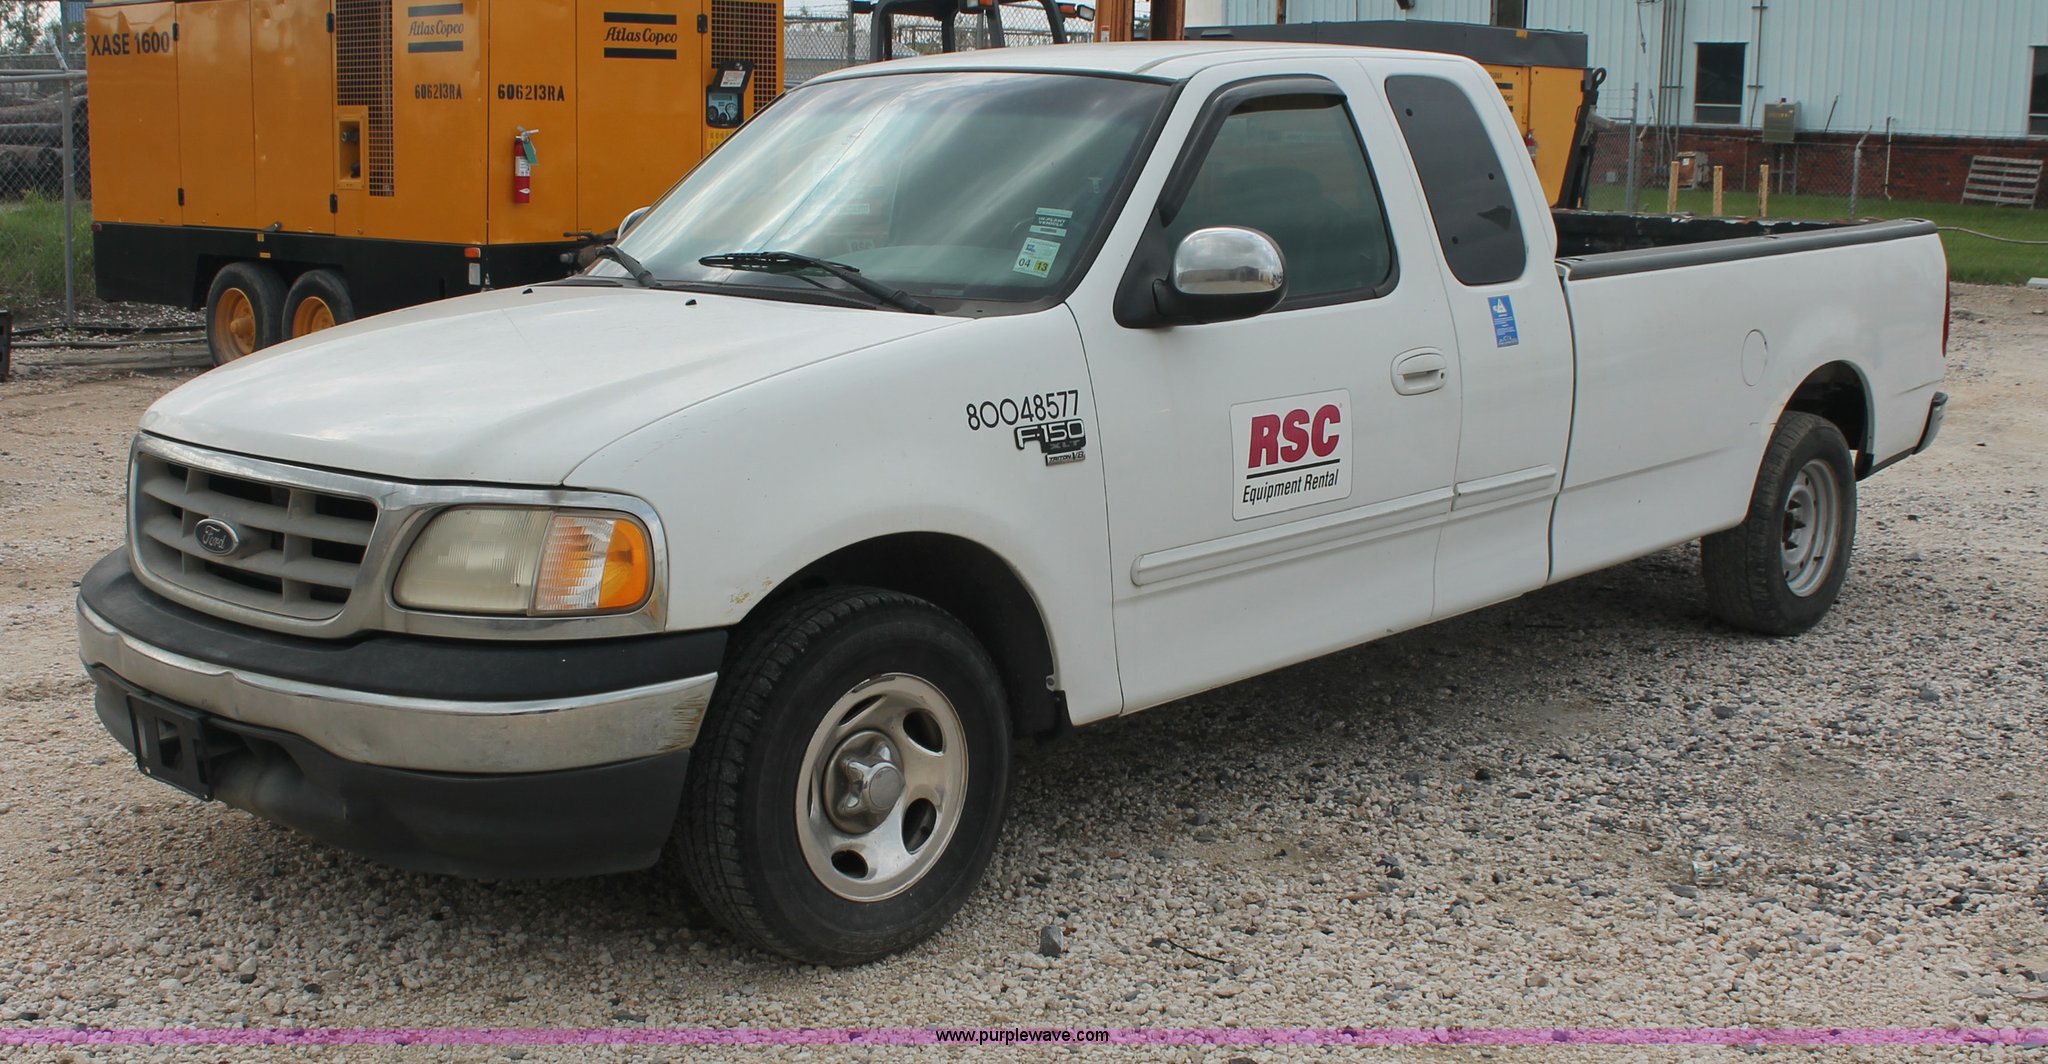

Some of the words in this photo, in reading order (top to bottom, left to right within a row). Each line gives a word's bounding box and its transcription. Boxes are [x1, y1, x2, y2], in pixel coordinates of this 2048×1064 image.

[408, 21, 434, 36] Atlas
[435, 20, 464, 37] Copco
[604, 26, 641, 42] Atlas
[642, 27, 678, 45] Copco
[90, 32, 130, 56] XASE
[135, 31, 170, 54] 1600
[414, 83, 462, 100] 606213RA
[497, 83, 565, 101] 606213RA
[1018, 258, 1031, 268] 04
[1036, 261, 1049, 272] 13
[966, 389, 1078, 431] 80048577
[1049, 439, 1081, 449] XLT
[1247, 404, 1341, 469] RSC
[1049, 453, 1071, 461] TRITON
[1242, 475, 1302, 505] Equipment
[1304, 469, 1339, 491] Rental
[202, 524, 228, 549] Ford
